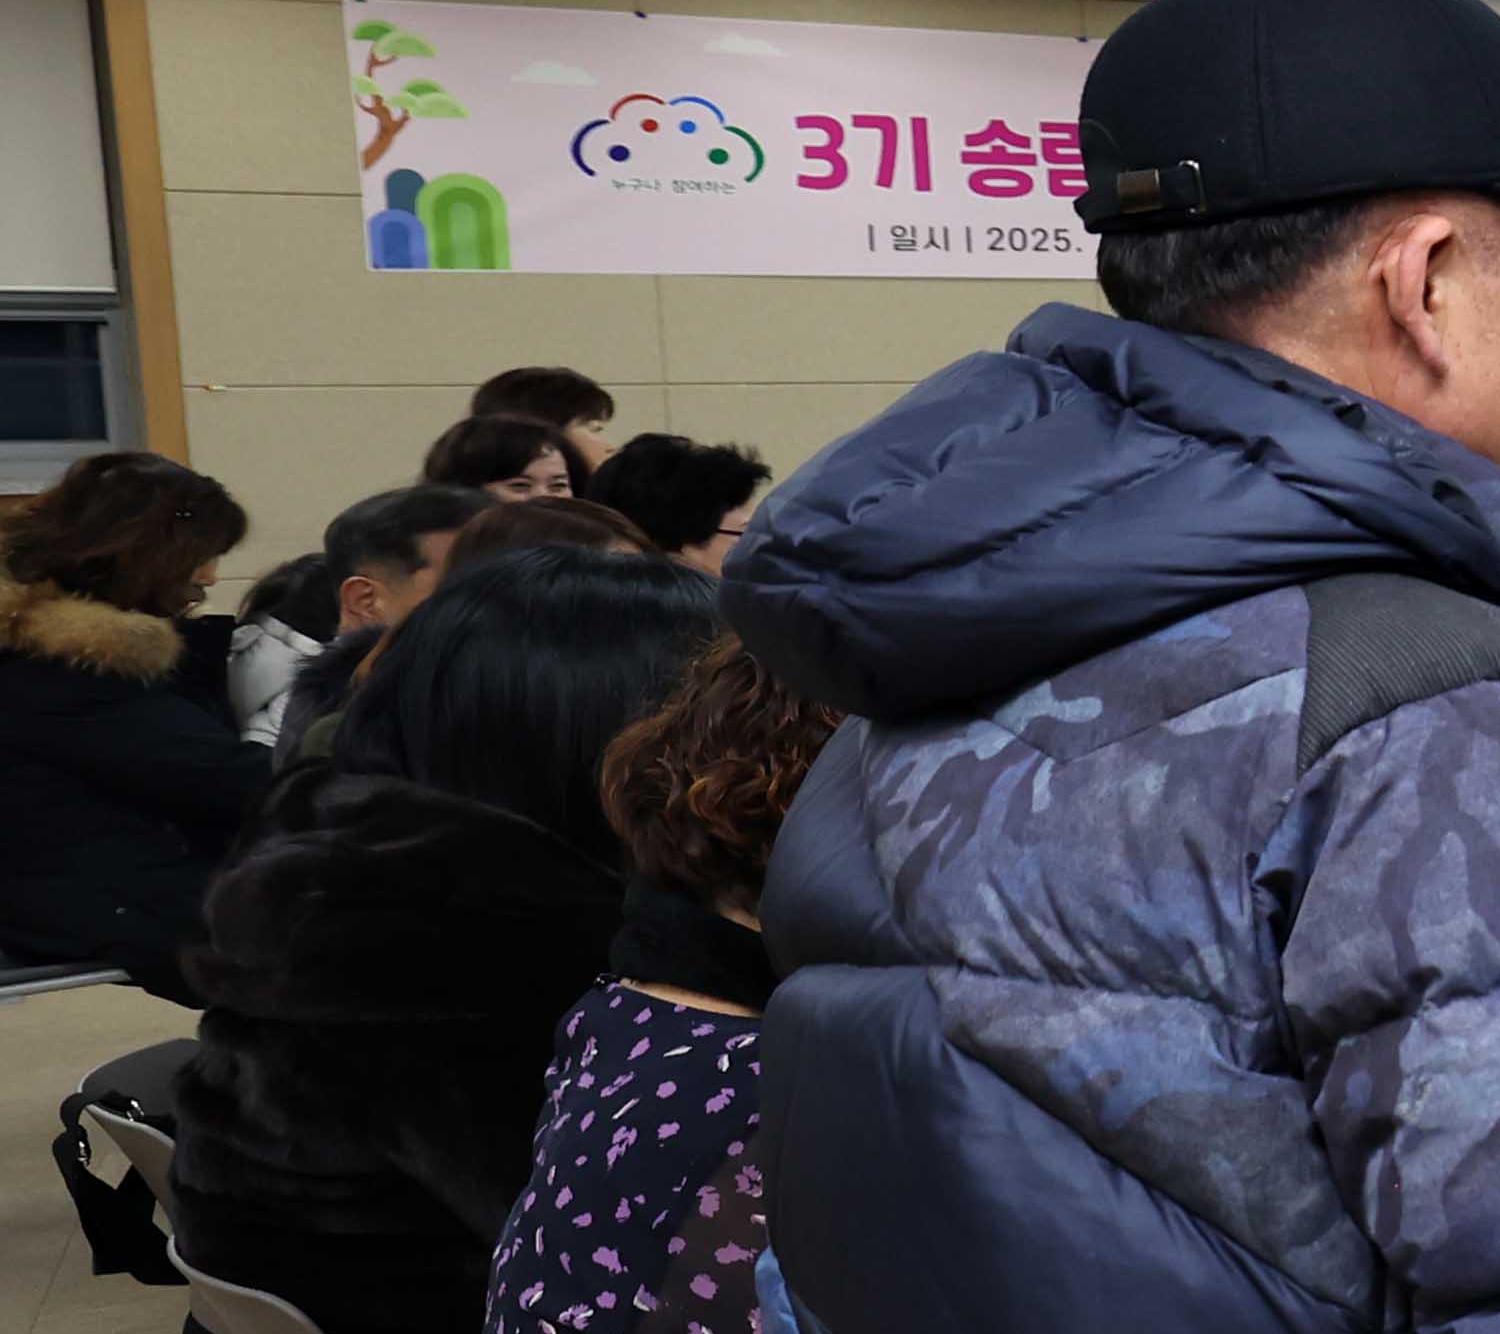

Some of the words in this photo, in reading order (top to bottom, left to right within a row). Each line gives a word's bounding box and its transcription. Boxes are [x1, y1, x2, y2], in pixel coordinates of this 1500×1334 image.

[795, 114, 932, 192] 3기
[889, 224, 951, 253] 일시
[985, 226, 1083, 253] 2025.
